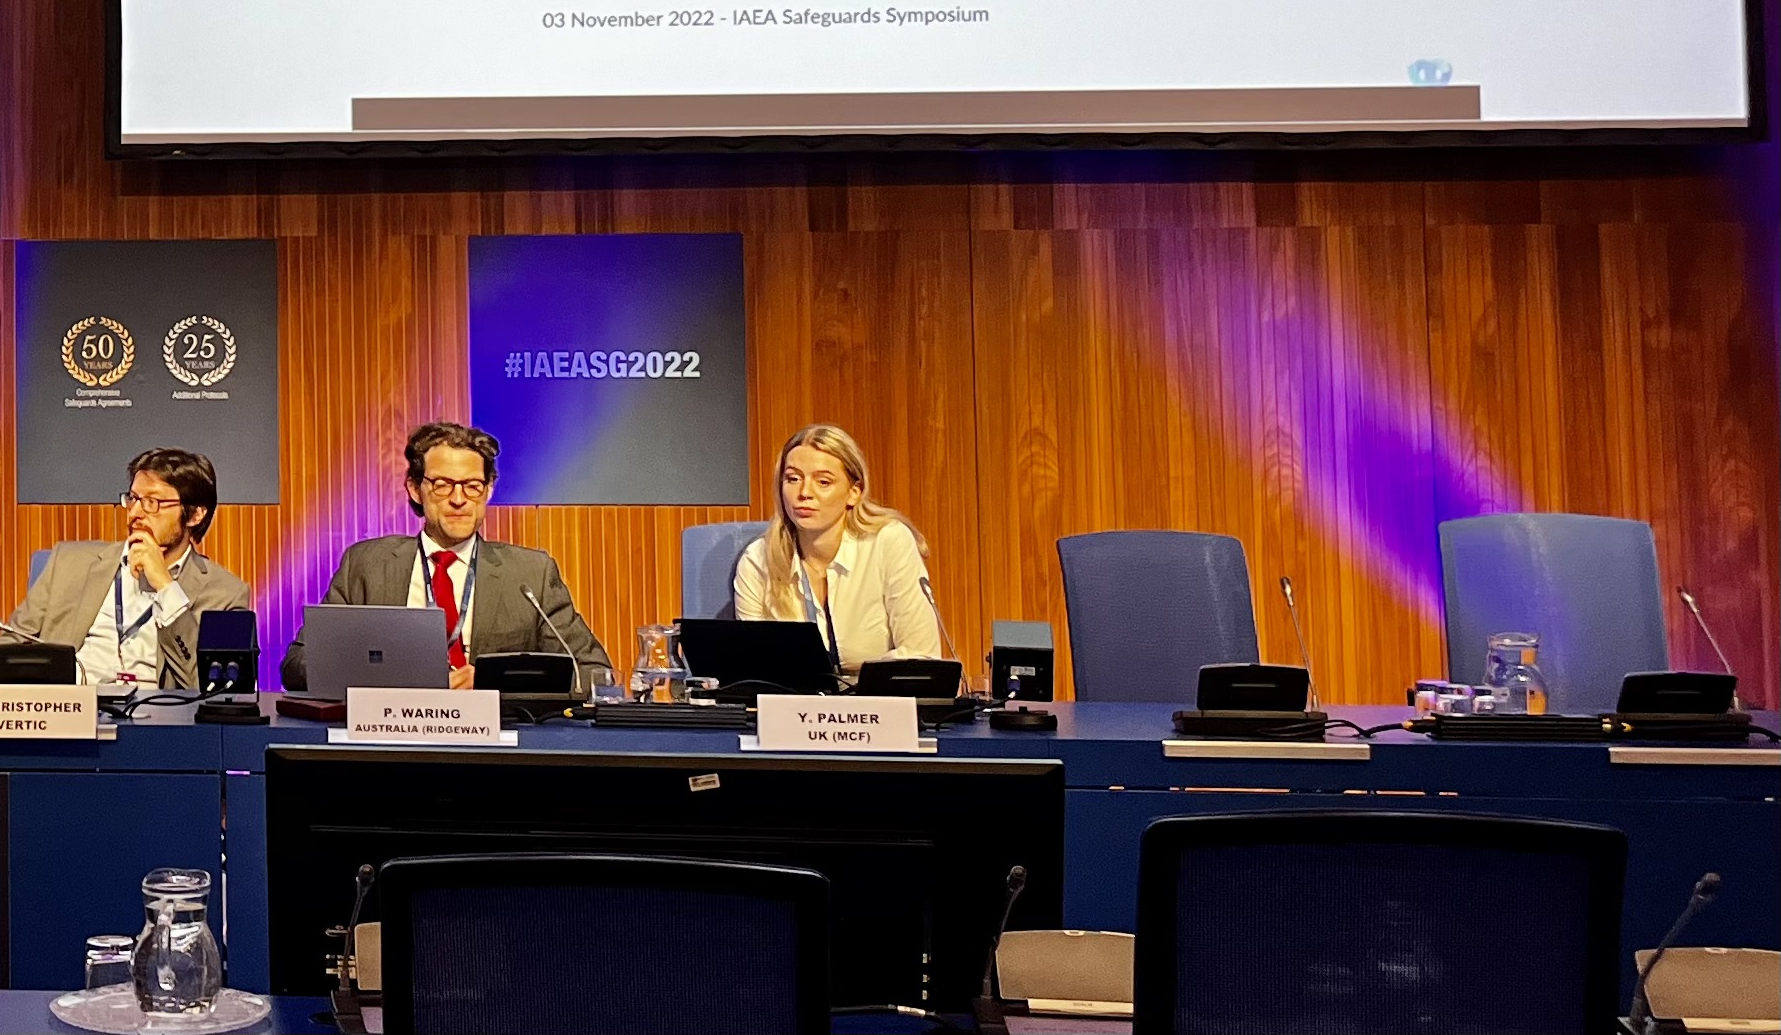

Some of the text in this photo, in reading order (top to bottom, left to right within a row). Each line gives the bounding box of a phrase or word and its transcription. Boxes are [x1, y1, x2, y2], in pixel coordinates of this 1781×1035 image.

[542, 12, 565, 28] 03
[572, 11, 663, 28] November
[669, 10, 714, 26] 2022
[734, 10, 777, 25] IAEA
[783, 8, 880, 27] Safeguards
[886, 6, 988, 26] Symposium
[82, 335, 113, 359] 50
[183, 334, 214, 358] 25
[83, 361, 113, 369] YEARS
[185, 360, 215, 369] YEARS
[504, 351, 700, 378] #IAEASG2022
[384, 708, 460, 718] P. WARING
[798, 713, 879, 724] Y. PALMER
[355, 724, 489, 736] AUSTRALIA (RIDGEWAY)
[809, 731, 870, 743] UK (MCF)
